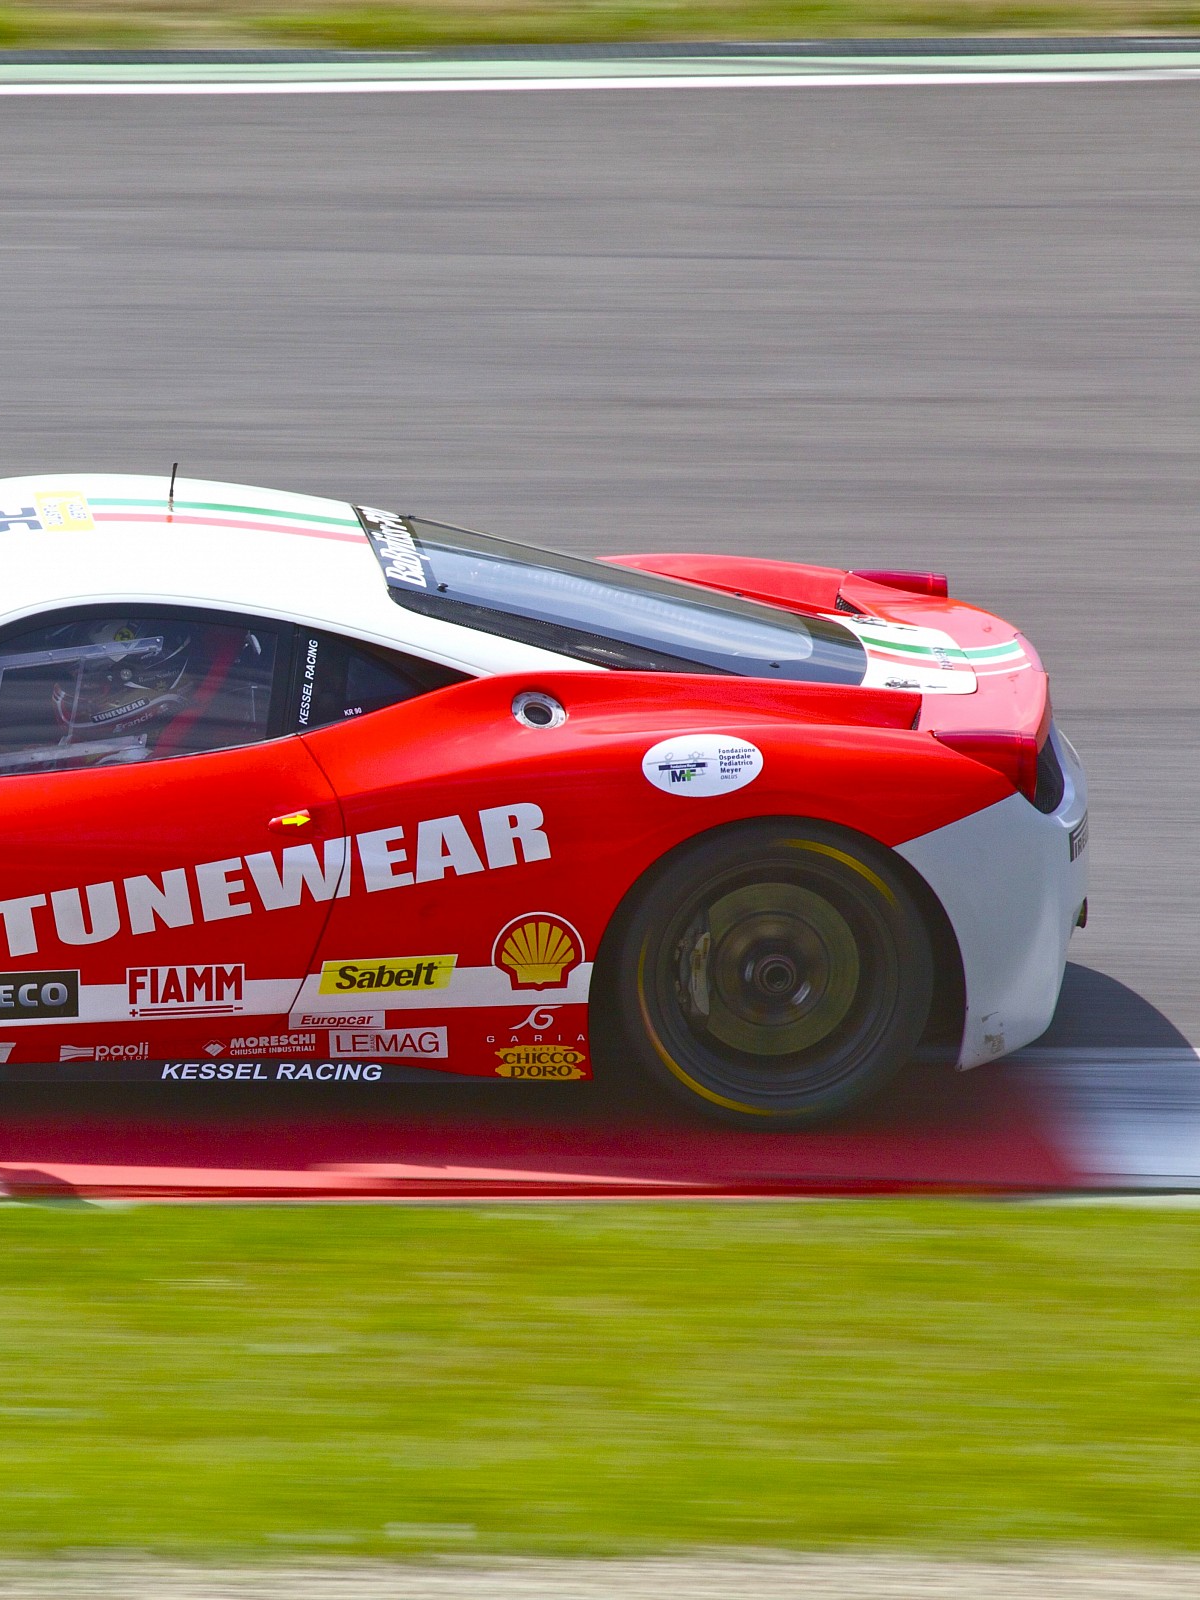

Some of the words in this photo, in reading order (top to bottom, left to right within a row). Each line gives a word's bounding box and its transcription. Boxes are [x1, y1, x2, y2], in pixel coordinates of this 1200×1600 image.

[304, 639, 319, 680] RACING
[92, 699, 146, 721] TUNEWEAR
[298, 682, 313, 725] KESSEL
[718, 753, 751, 761] Ospedale
[720, 767, 742, 775] Meyer
[335, 962, 439, 990] Sabelt
[128, 965, 244, 1005] FIAMM
[300, 1014, 374, 1028] Europcar
[230, 1033, 316, 1048] MORESCHI
[486, 1034, 586, 1043] GARIA
[95, 1042, 149, 1061] paoli
[230, 1048, 267, 1056] CHIUSURE
[502, 1052, 579, 1065] CHICCO
[161, 1063, 268, 1080] KESSEL
[276, 1063, 383, 1081] RACING
[510, 1065, 573, 1077] D'ORO
